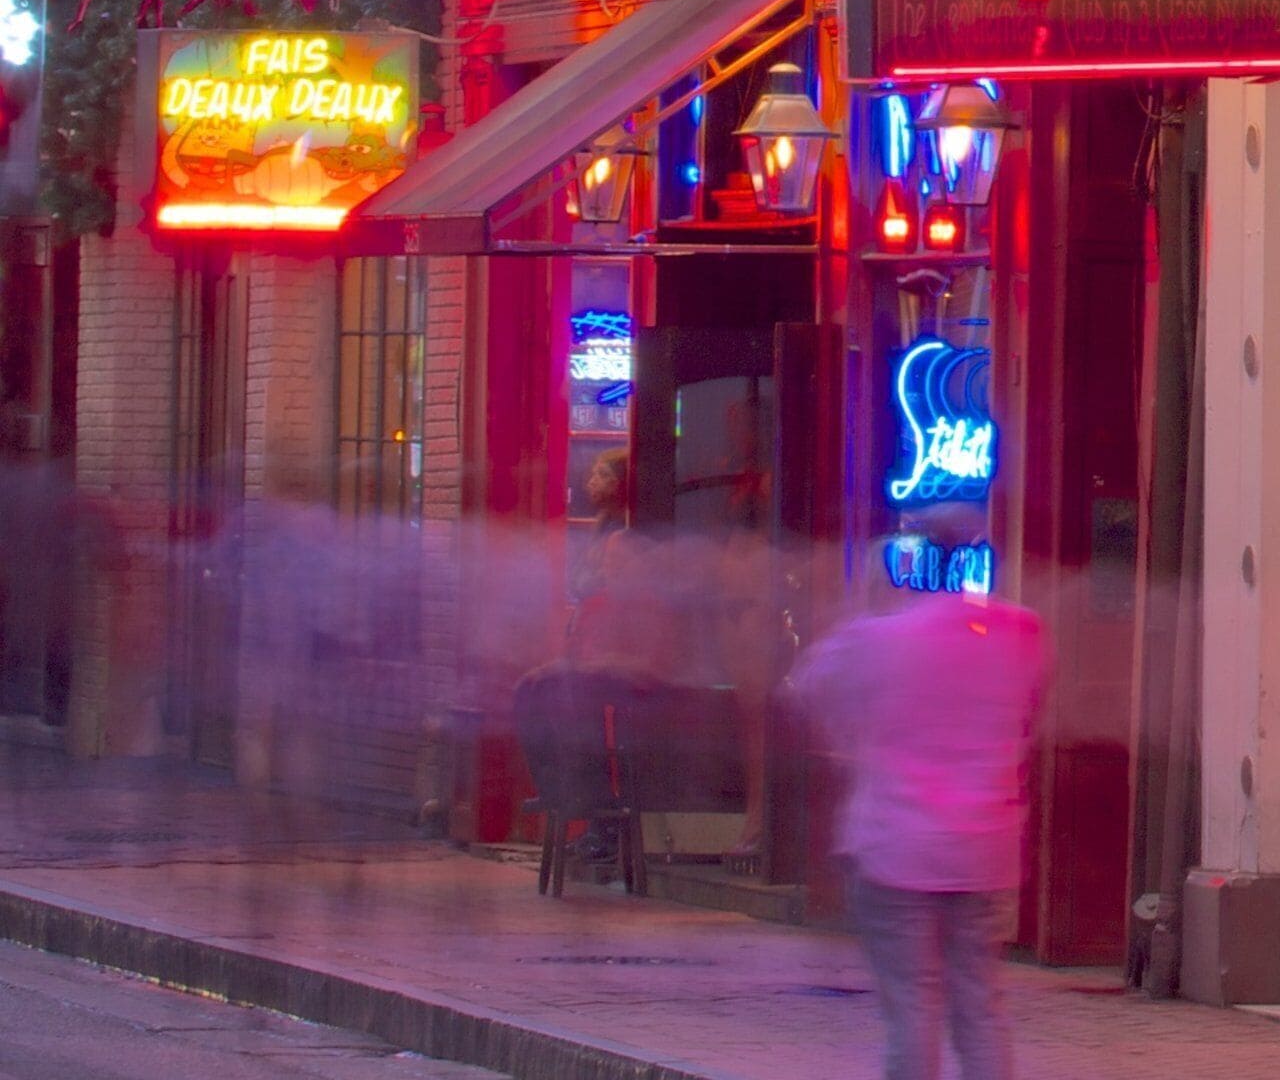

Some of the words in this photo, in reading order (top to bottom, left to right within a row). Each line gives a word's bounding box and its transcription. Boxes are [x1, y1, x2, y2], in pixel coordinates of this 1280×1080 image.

[247, 38, 329, 74] FAIS
[166, 78, 279, 122] DEAUX
[290, 78, 402, 123] DEAUX
